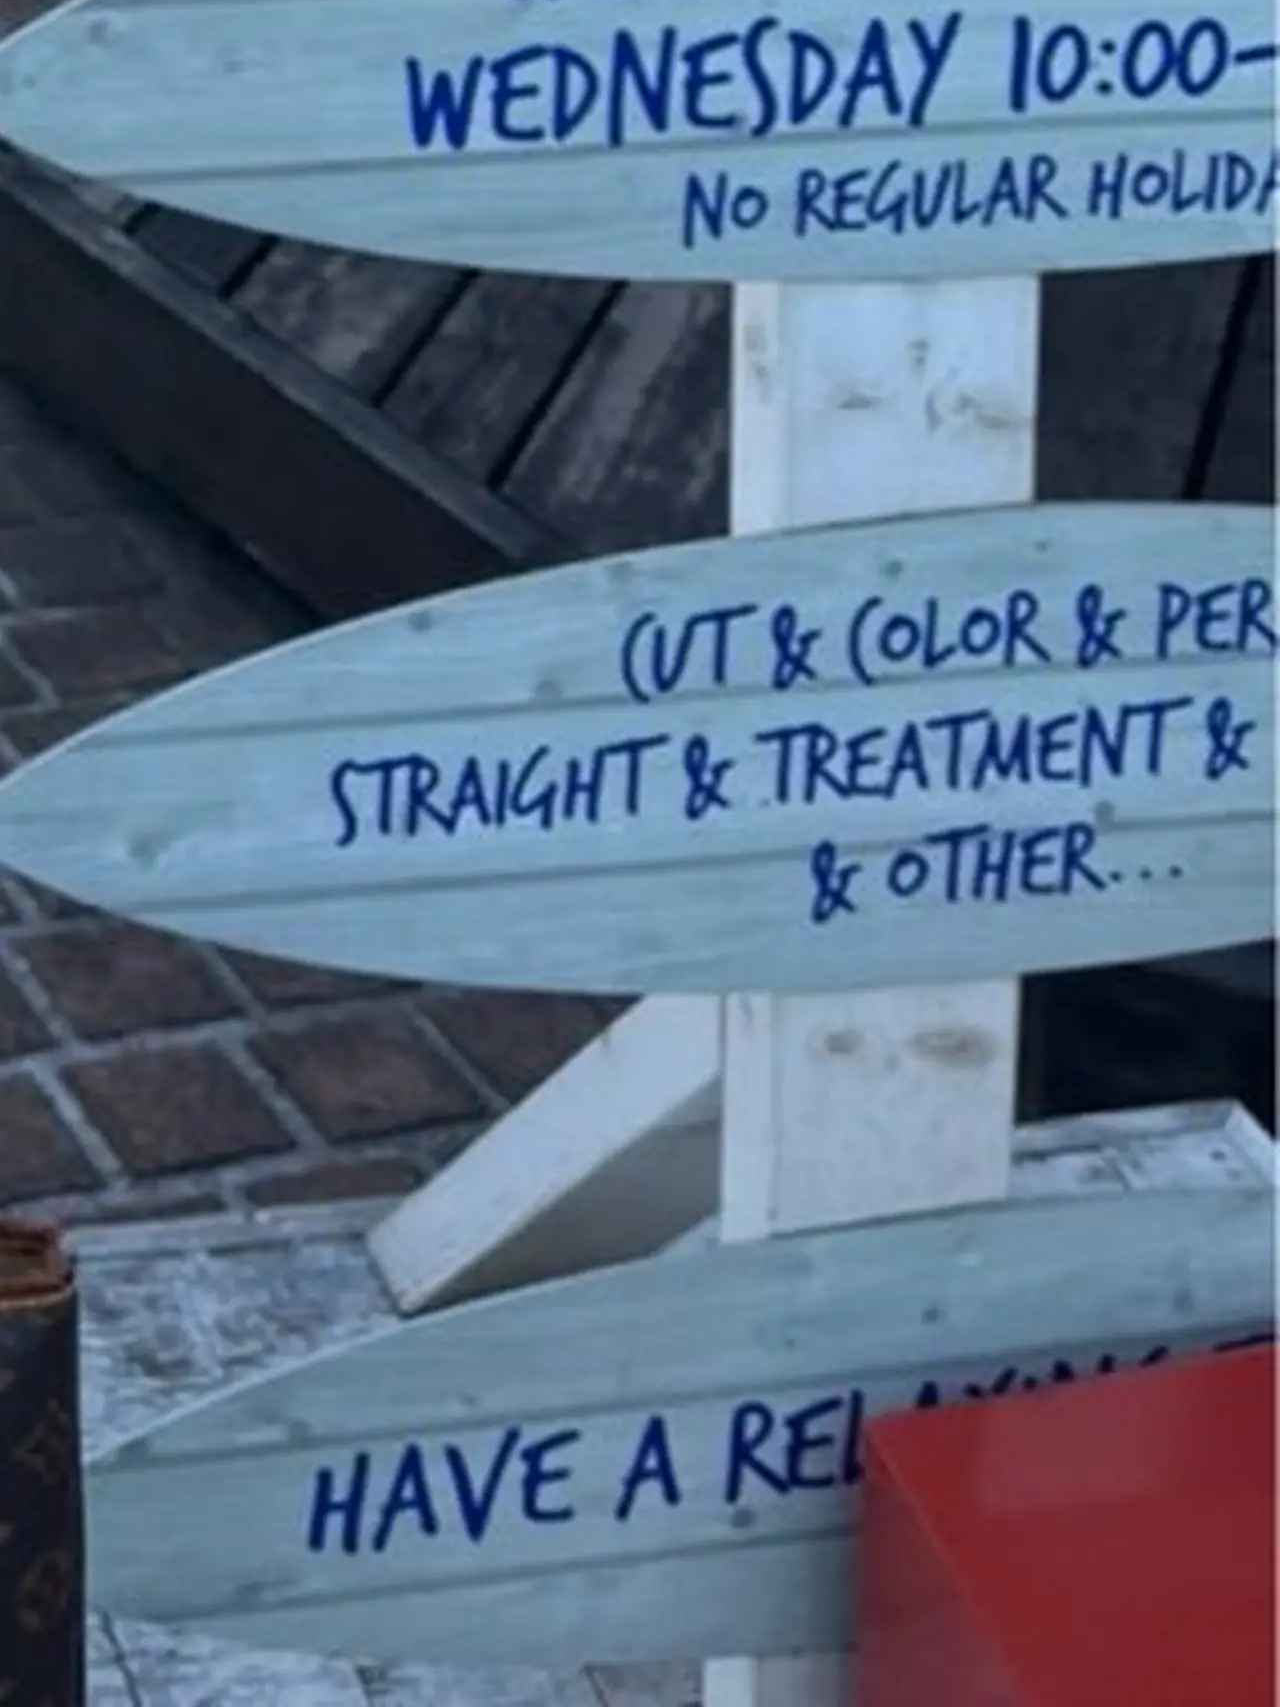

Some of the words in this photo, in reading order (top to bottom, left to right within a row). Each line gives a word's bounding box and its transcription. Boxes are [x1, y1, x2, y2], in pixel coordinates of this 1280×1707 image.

[405, 12, 963, 150] WEDNESDAY
[682, 171, 769, 249] NO
[795, 154, 1069, 235] REGULAR
[620, 603, 758, 701] CUT
[772, 604, 822, 689] &
[848, 589, 1052, 687] COLOR
[1075, 583, 1127, 669] &
[329, 734, 671, 847] STRAIGHT
[684, 734, 735, 820] &
[755, 696, 1194, 810] TREATMENT
[1205, 696, 1258, 781] &
[811, 839, 862, 923] &
[306, 1426, 580, 1556] HAVE
[615, 1414, 681, 1522] A
